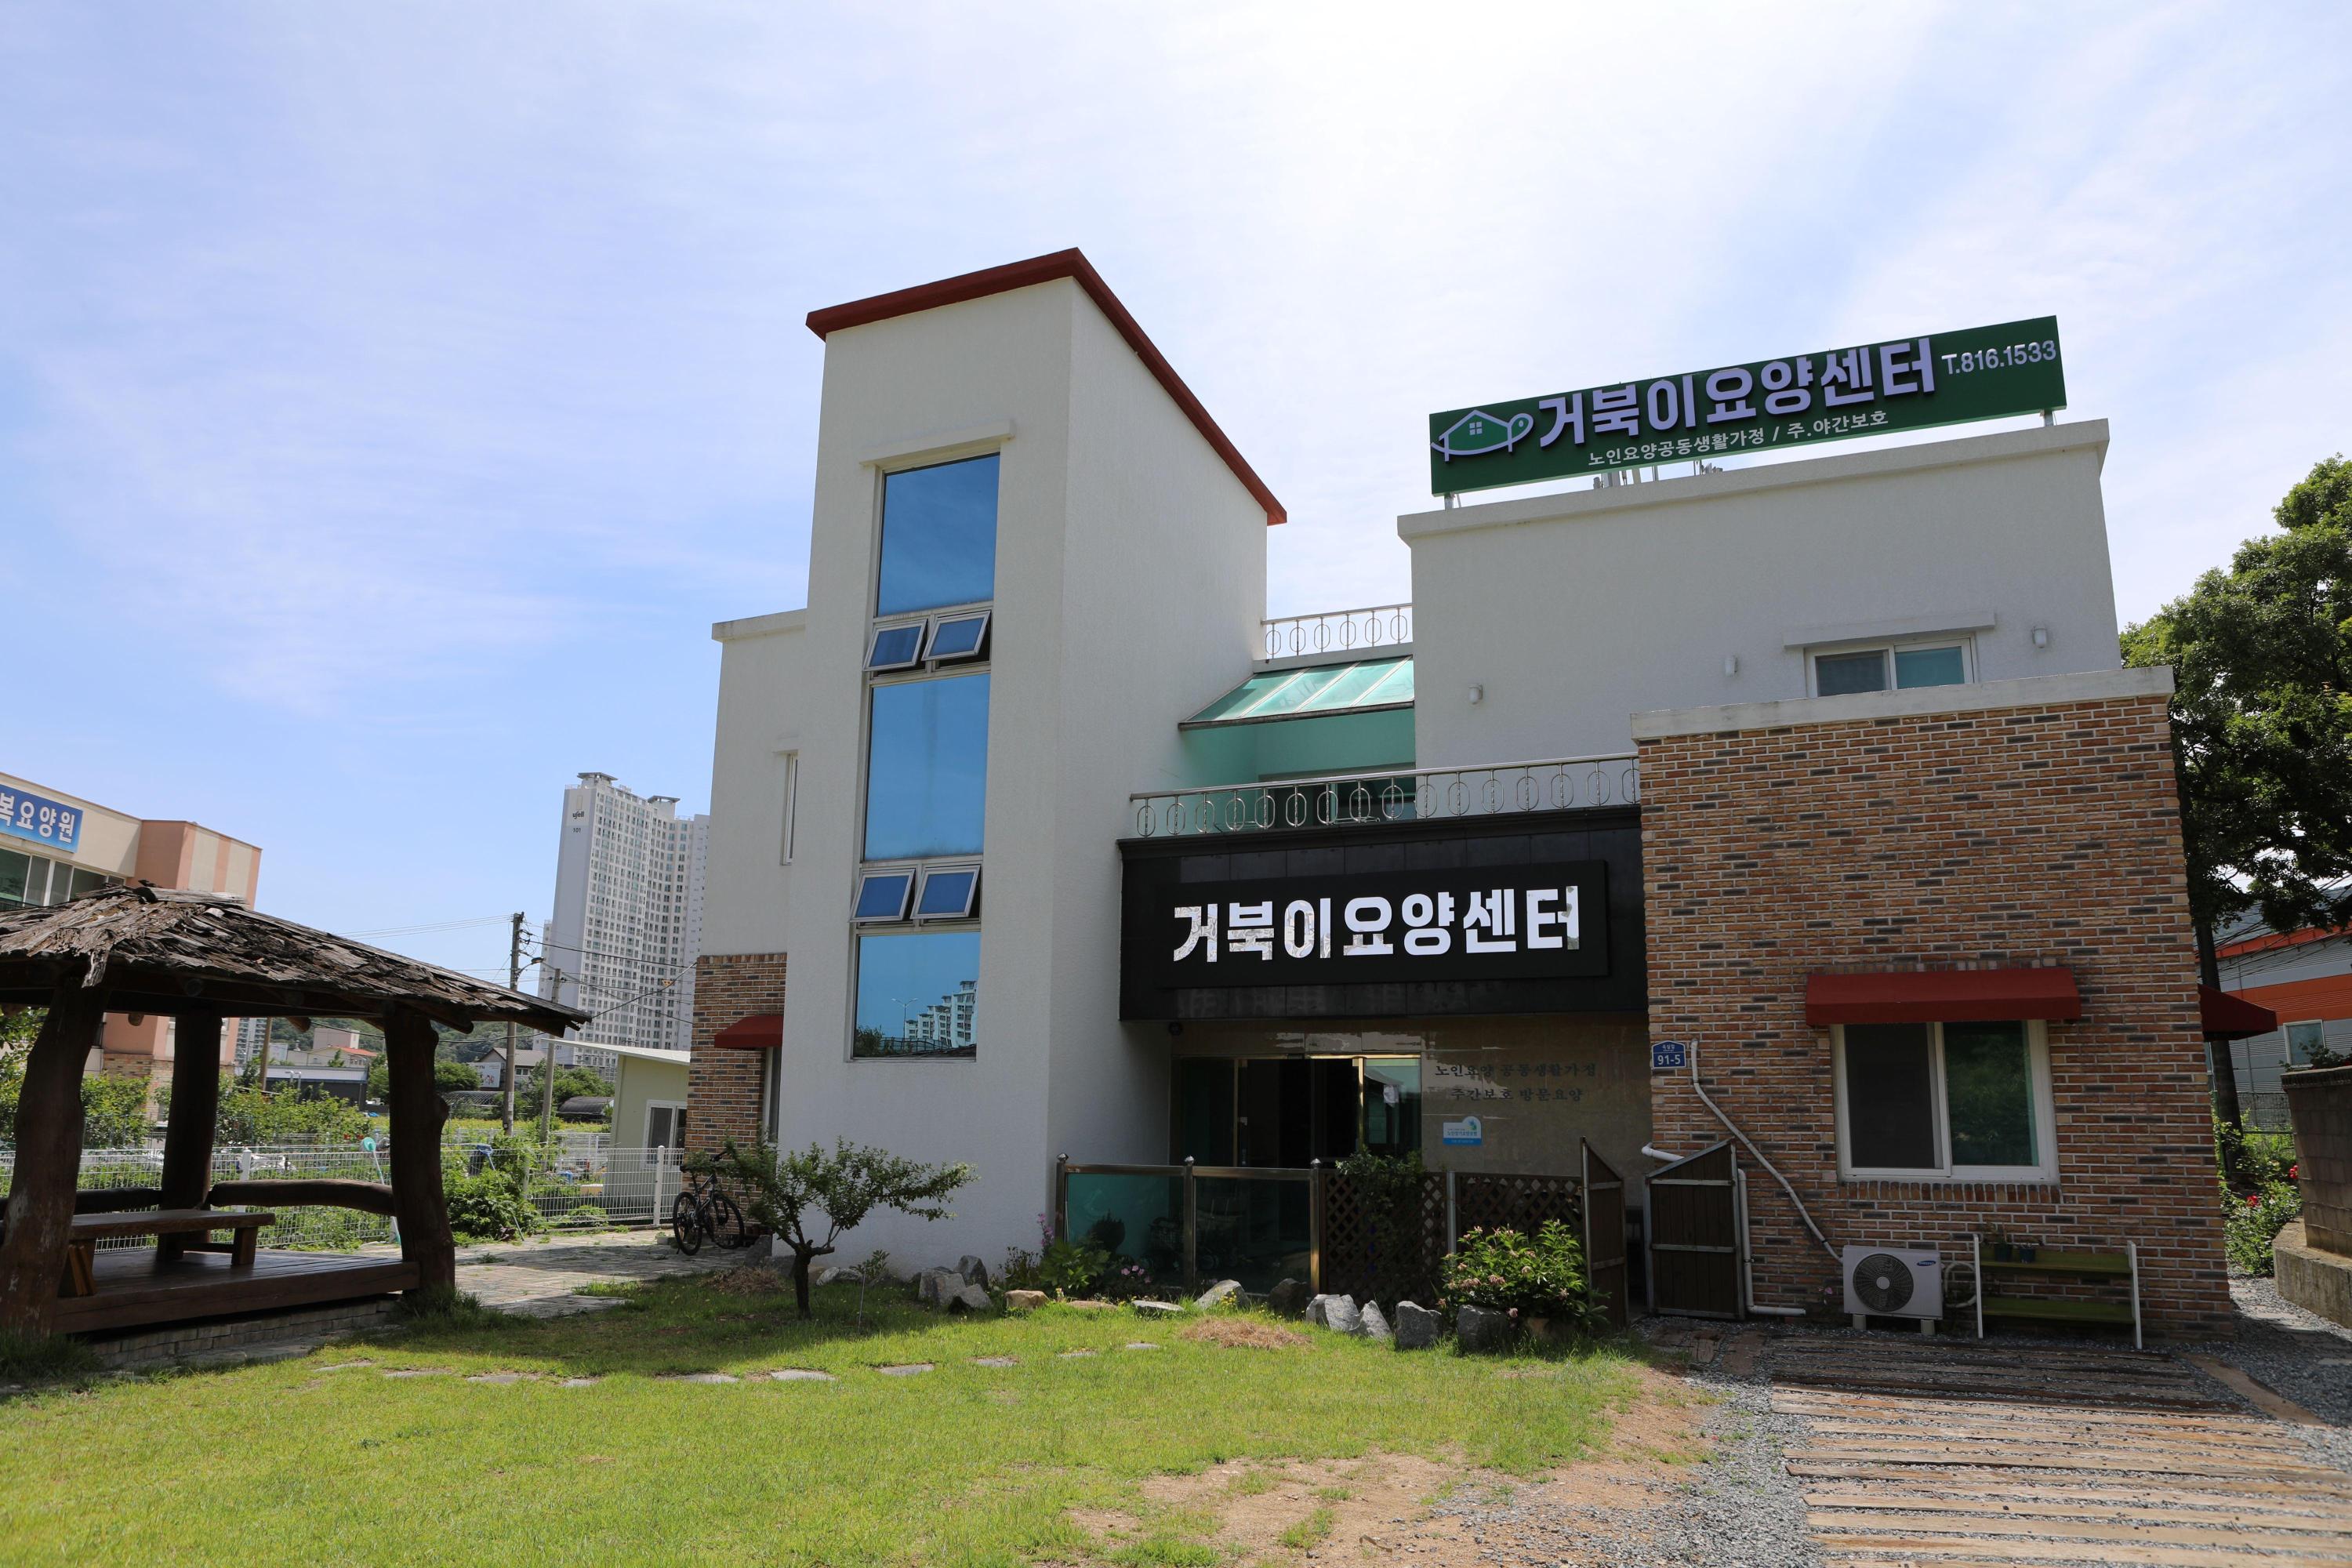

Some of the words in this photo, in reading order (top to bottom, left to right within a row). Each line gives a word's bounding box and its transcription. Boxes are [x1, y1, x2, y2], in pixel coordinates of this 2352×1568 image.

[1538, 337, 1935, 448] 거북이요양센터
[1941, 339, 2056, 375] T.816.1533
[1588, 428, 1764, 466] 노인요양공동생활가정
[1787, 410, 1889, 438] 주.야간보호
[1174, 885, 1580, 963] 거북이요양센터
[1657, 1054, 1681, 1065] 91-5
[1451, 1087, 1514, 1102] 주간보호
